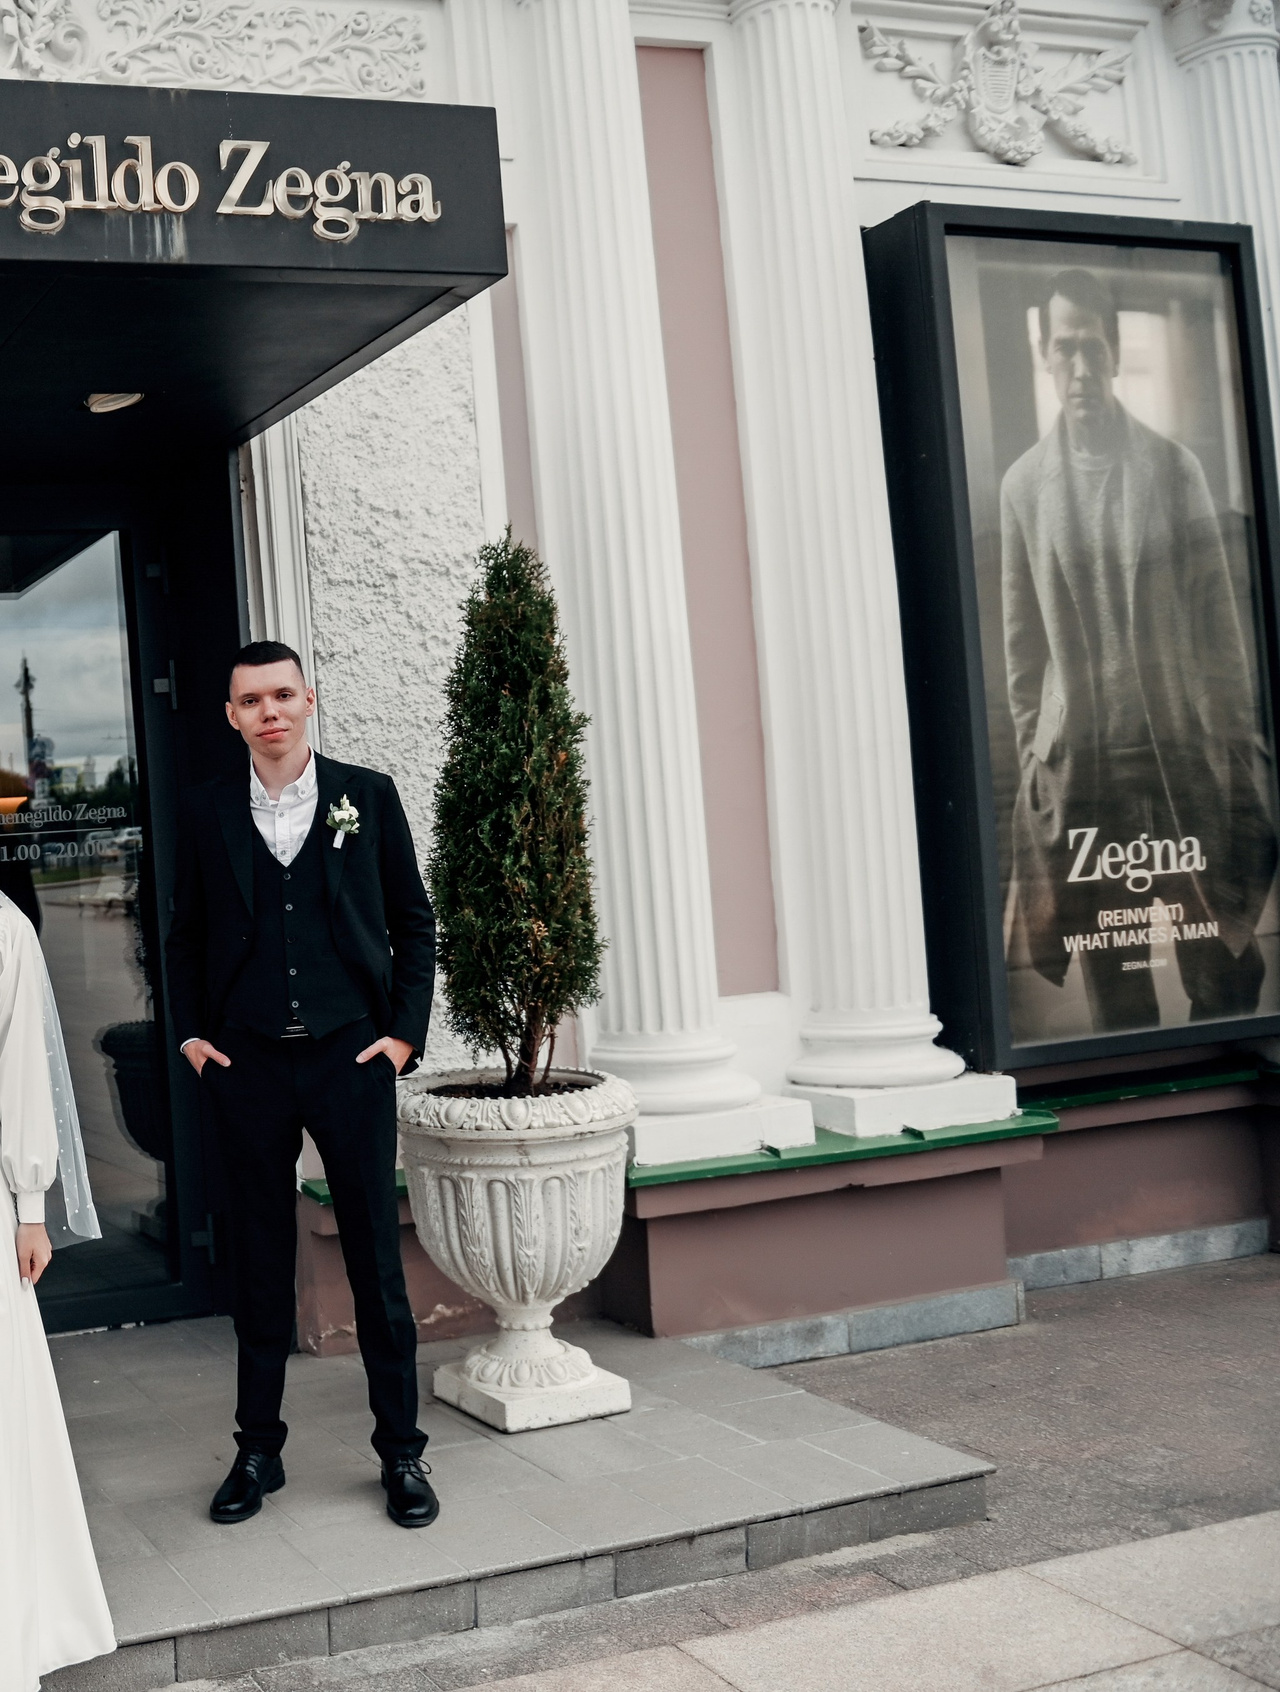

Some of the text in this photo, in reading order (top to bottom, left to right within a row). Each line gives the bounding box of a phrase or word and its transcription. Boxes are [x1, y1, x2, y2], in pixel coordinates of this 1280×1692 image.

[216, 139, 441, 242] Zegna
[75, 803, 127, 824] Zegna
[54, 841, 106, 859] 20.00
[1067, 827, 1206, 892] Zegna
[1098, 903, 1184, 930] (REINVENT)
[1063, 921, 1219, 953] WHAT MAKES A MAN
